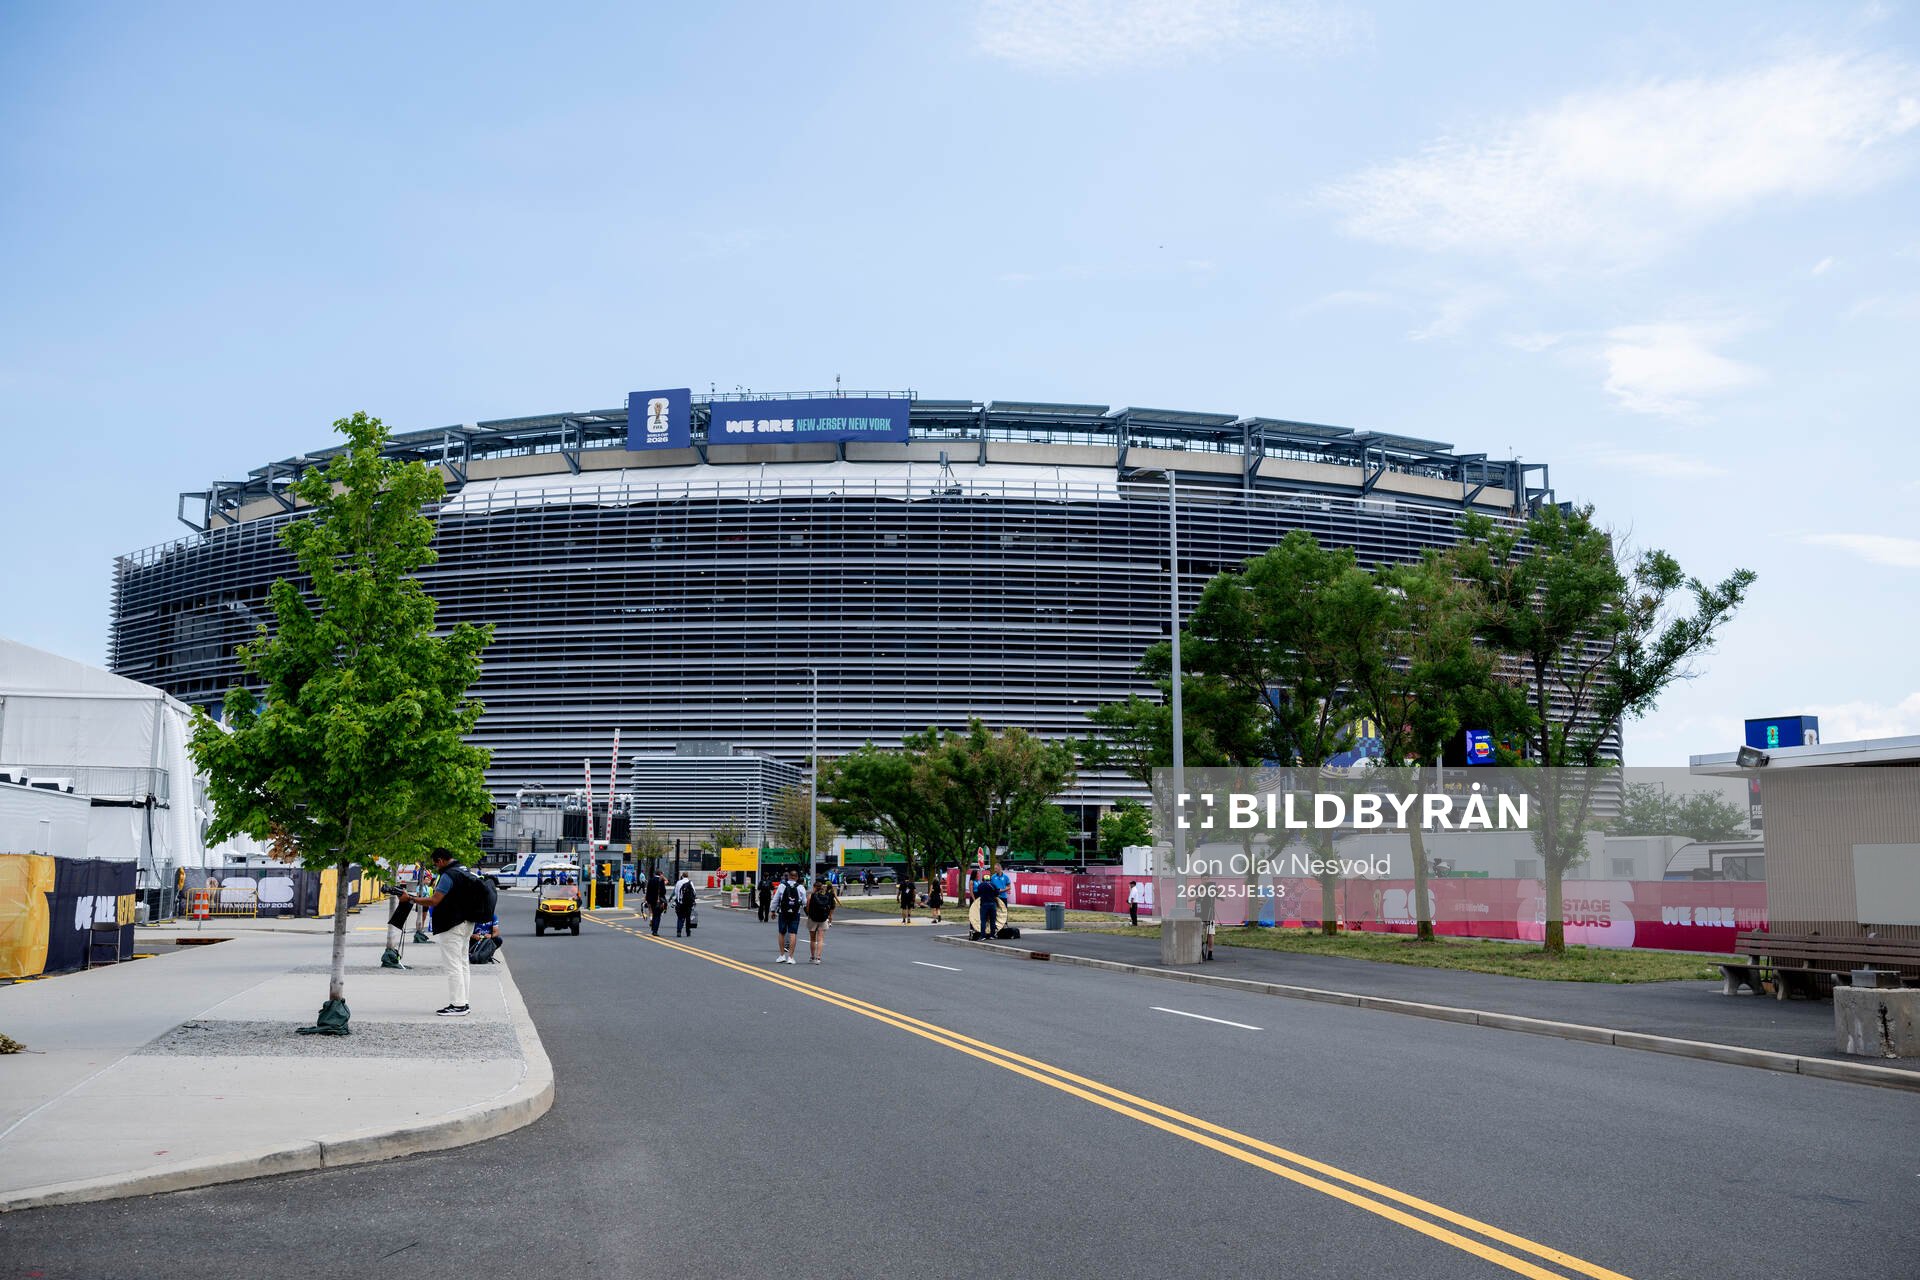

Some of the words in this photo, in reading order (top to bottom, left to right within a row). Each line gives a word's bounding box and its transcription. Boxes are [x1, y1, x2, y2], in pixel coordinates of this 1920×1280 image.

[726, 420, 754, 433] WE
[757, 419, 794, 433] ARE
[797, 418, 816, 432] NEW
[816, 417, 847, 431] JERSEY
[849, 417, 869, 431] NEW
[869, 418, 891, 431] YORK
[1563, 899, 1611, 912] STAGE
[1562, 913, 1612, 928] OURS
[1662, 906, 1692, 926] WE
[1695, 907, 1736, 928] ARE
